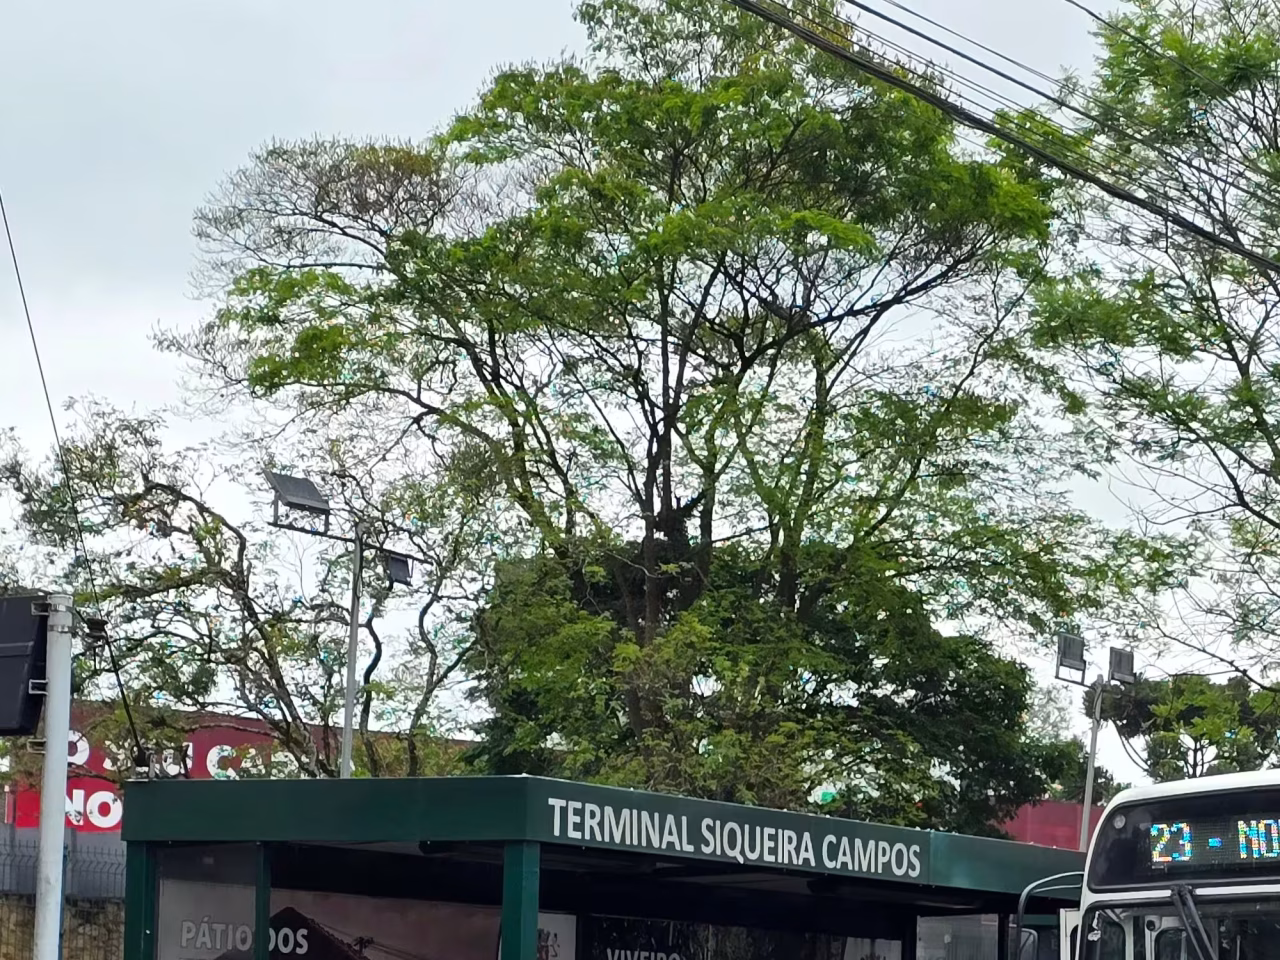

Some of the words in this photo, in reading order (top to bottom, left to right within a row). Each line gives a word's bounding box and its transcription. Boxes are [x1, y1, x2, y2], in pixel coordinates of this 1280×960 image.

[548, 797, 695, 852] TERMINAL
[701, 817, 815, 867] SIQUEIRA
[822, 834, 921, 878] CAMPOS
[1151, 822, 1193, 862] 23
[181, 916, 253, 951] PÁTIO
